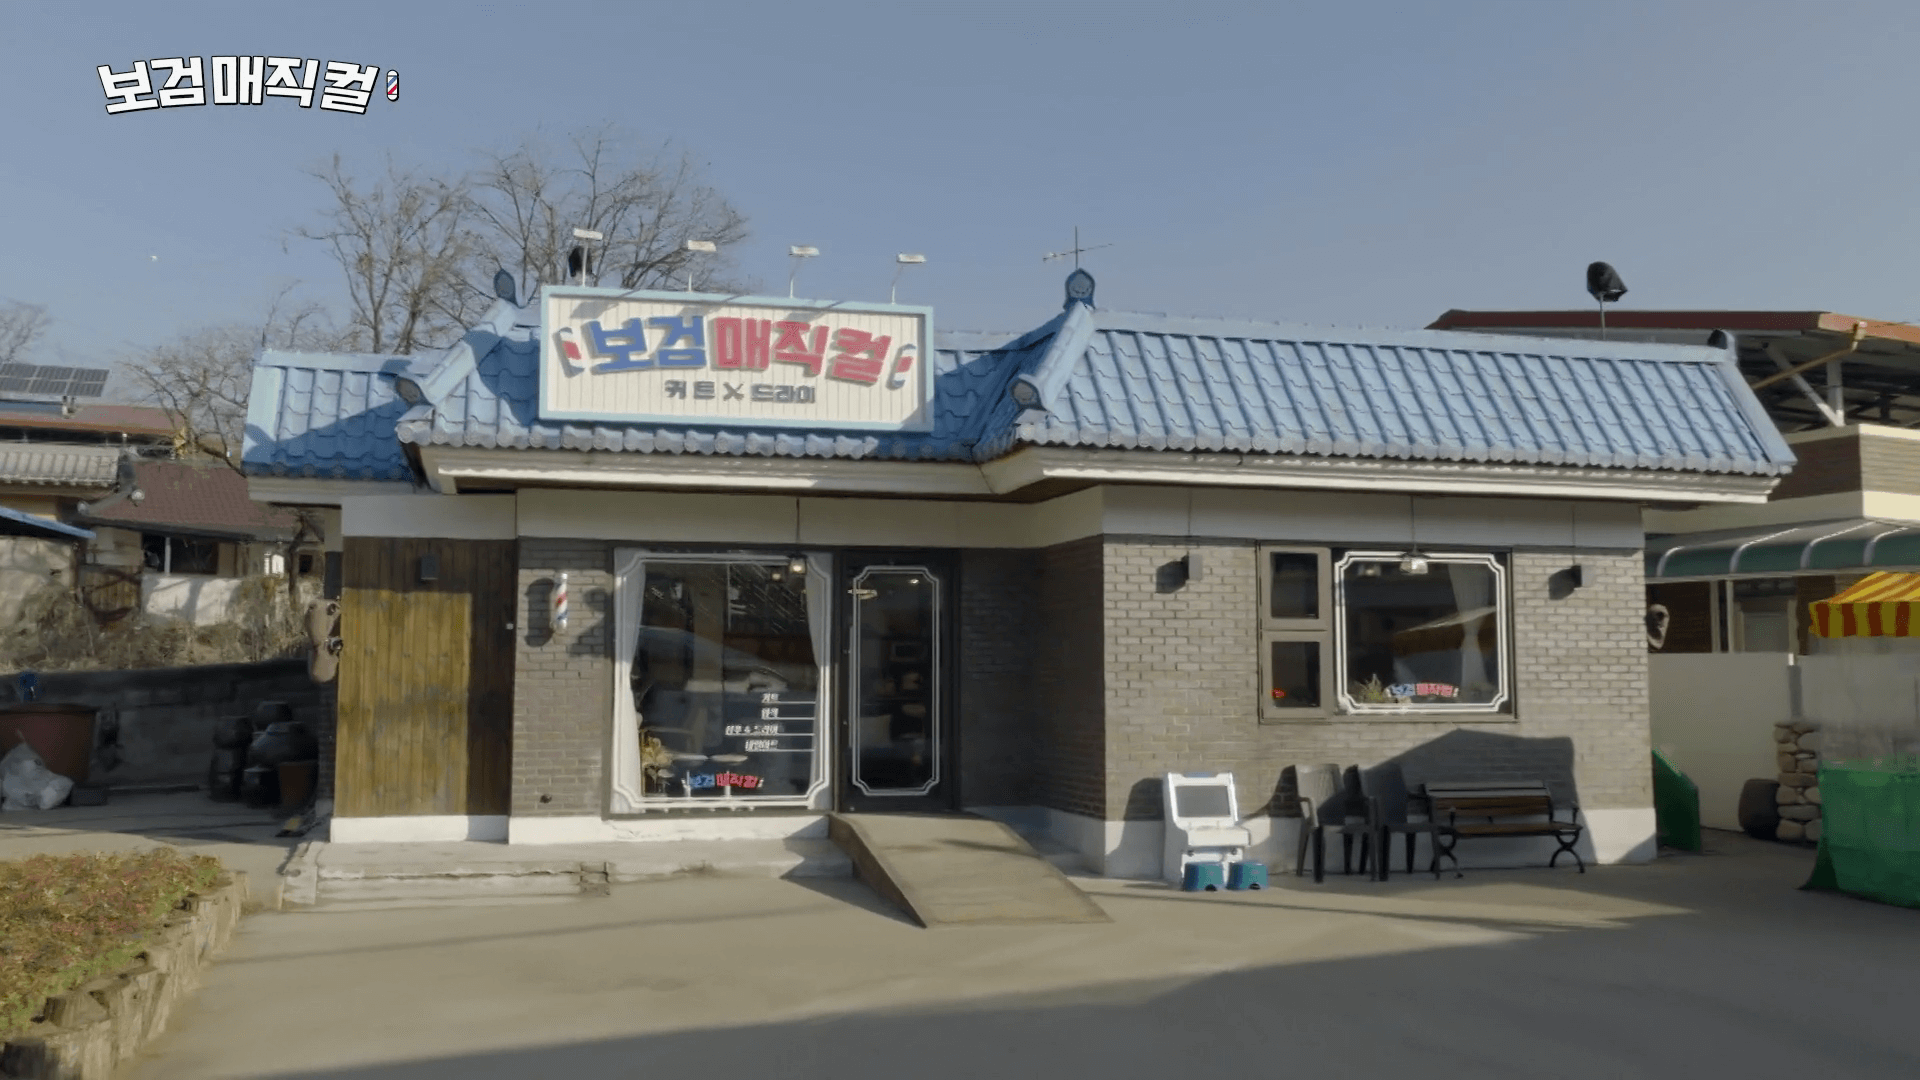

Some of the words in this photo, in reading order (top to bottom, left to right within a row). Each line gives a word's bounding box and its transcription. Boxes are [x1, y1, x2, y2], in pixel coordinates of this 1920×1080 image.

[582, 314, 708, 376] 보검
[711, 316, 892, 386] 매직컬
[751, 383, 816, 404] 드라이
